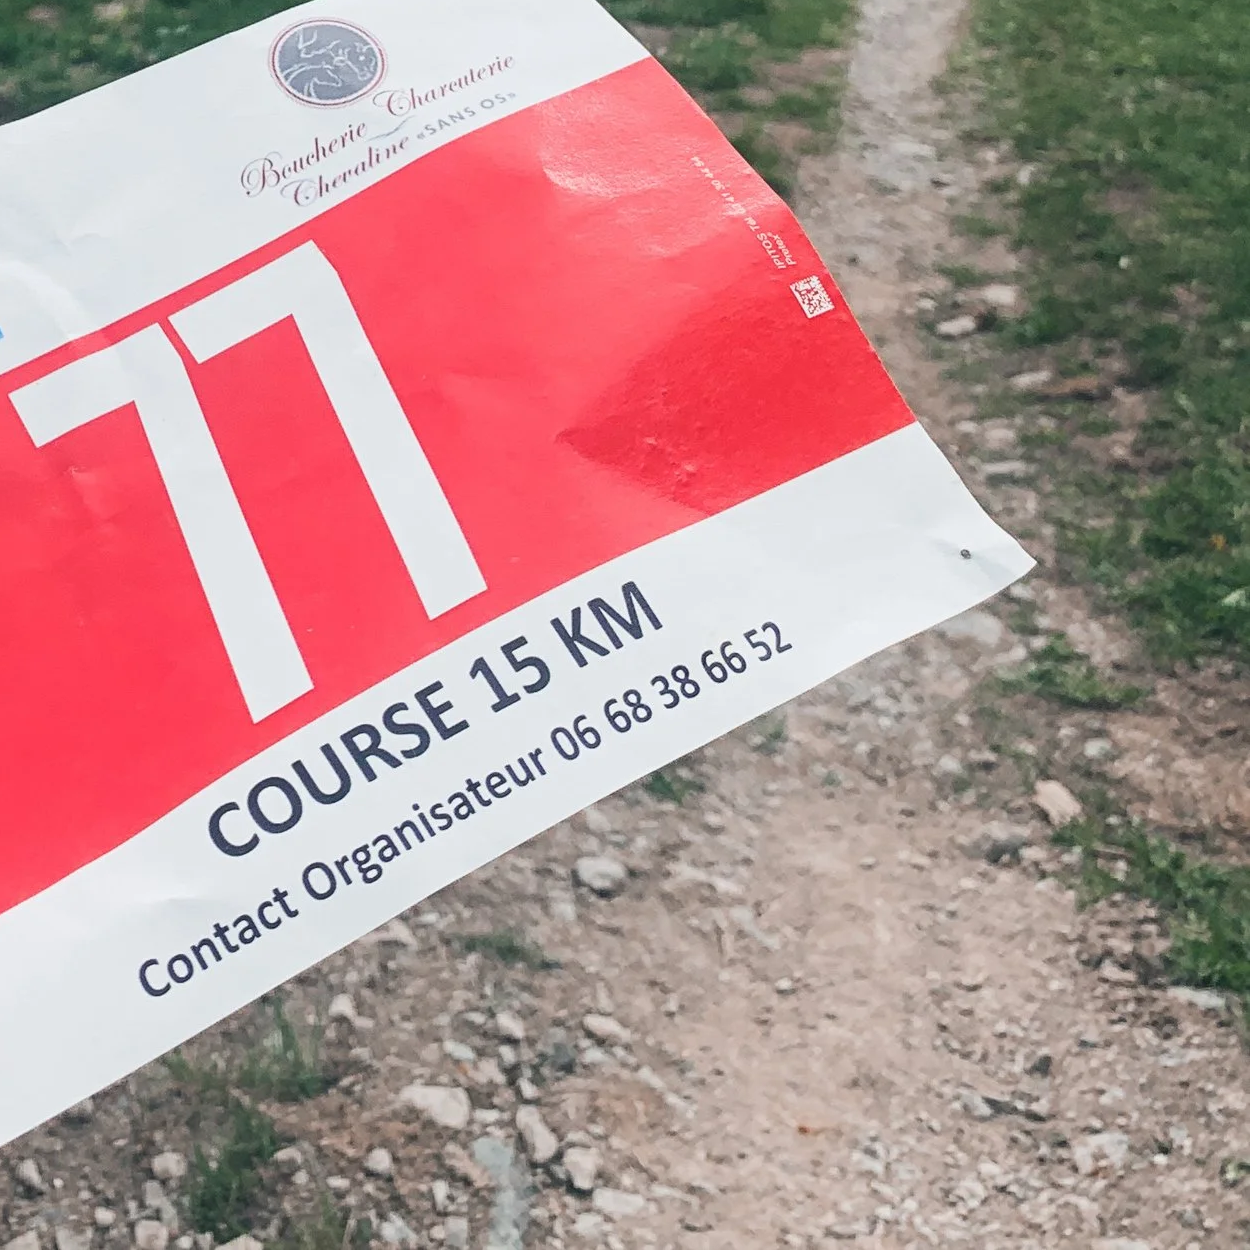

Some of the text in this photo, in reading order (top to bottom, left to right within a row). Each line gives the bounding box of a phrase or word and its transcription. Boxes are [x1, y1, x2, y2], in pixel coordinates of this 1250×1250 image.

[240, 53, 514, 198] Boucherie Charcuterie
[280, 136, 409, 207] Chevaline
[756, 232, 787, 269] IPITOS
[7, 238, 489, 725] 77
[137, 620, 794, 998] Contact Organisateur 06 68 38 66 52
[207, 580, 664, 858] COURSE 15 KM
